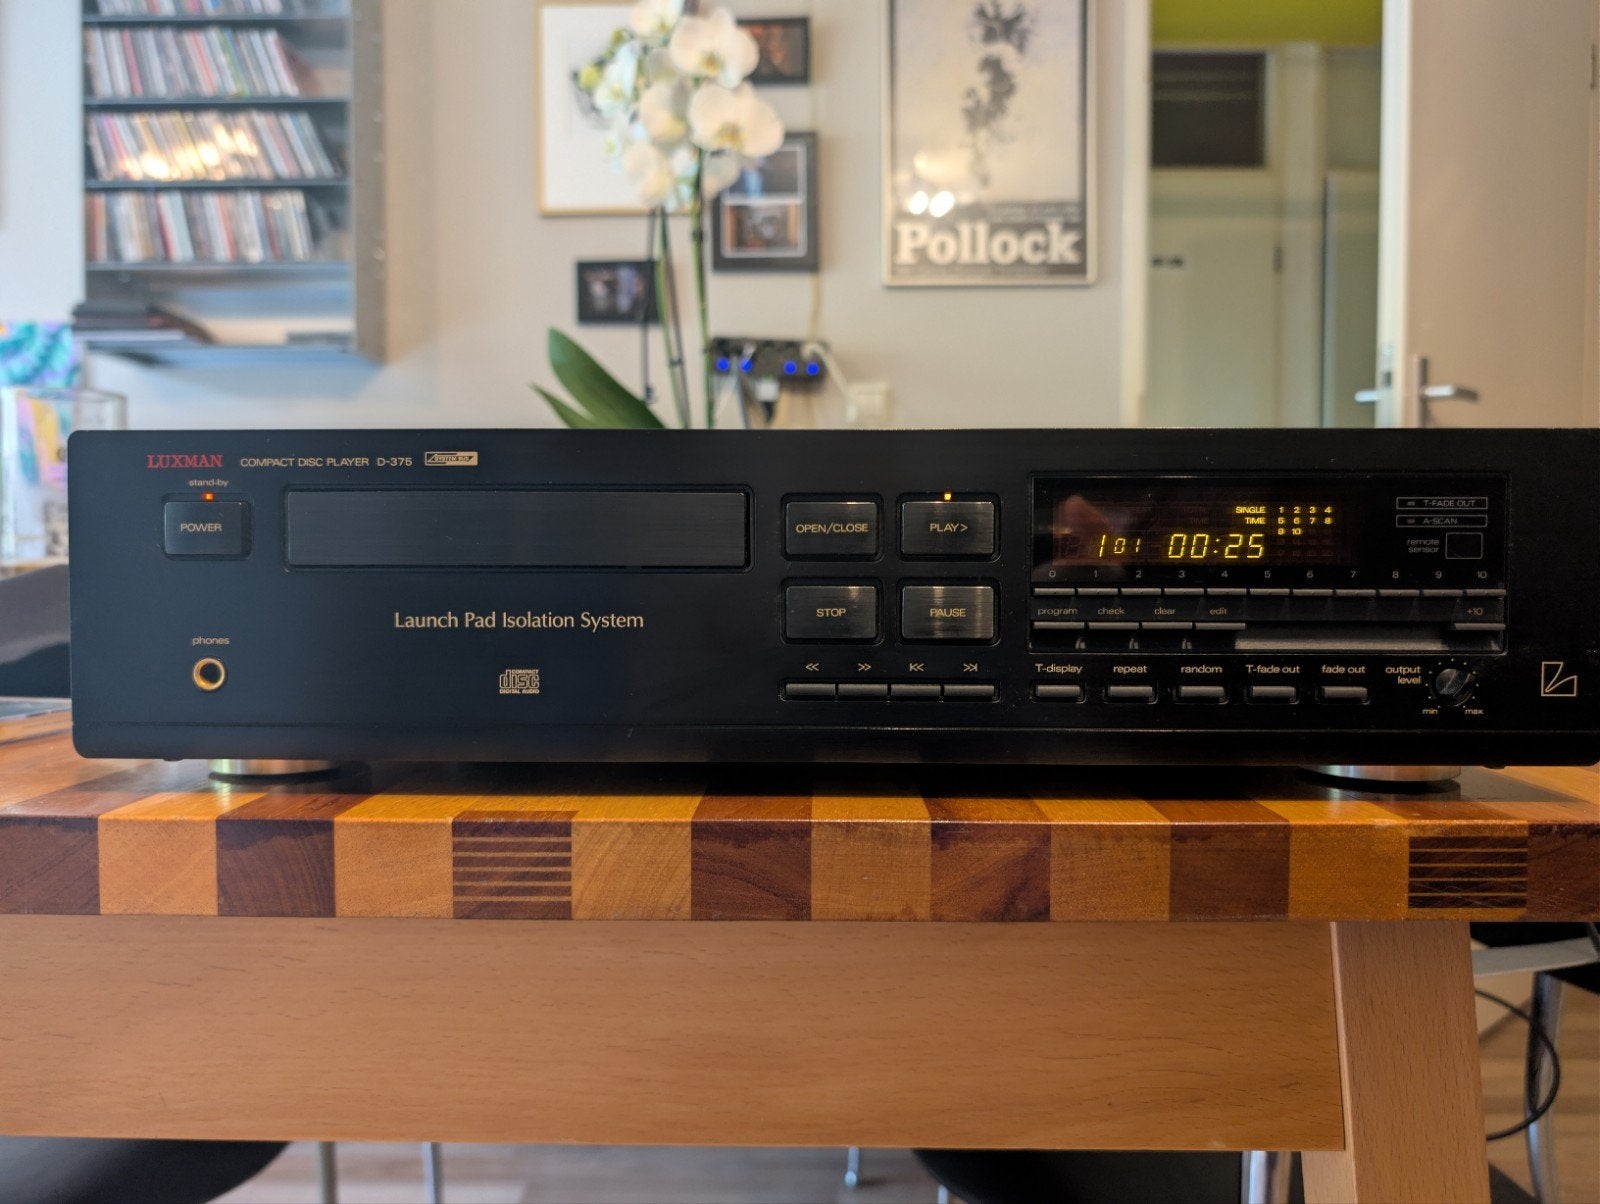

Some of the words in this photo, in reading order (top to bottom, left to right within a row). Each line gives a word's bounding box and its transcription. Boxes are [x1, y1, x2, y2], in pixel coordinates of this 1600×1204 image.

[895, 218, 1082, 266] Pollock
[146, 454, 224, 469] LUXMAN
[240, 457, 295, 467] COMPACT
[298, 457, 323, 467] DISC
[326, 457, 370, 467] PLAYER
[377, 457, 413, 467] D-375
[188, 478, 229, 488] stand-by
[1424, 499, 1455, 507] T-FADE
[1456, 499, 1476, 507] OUT
[1235, 506, 1267, 515] SINGLE
[1278, 506, 1285, 514] 1
[1293, 506, 1301, 514] 2
[1309, 506, 1317, 514] 3
[1324, 506, 1333, 514] 4
[1244, 517, 1267, 525] TIME
[1277, 517, 1285, 525] 5
[1293, 517, 1301, 525] 6
[1309, 517, 1317, 525] 7
[1422, 517, 1458, 525] A-SCAN
[180, 523, 223, 532] POWER
[795, 522, 869, 534] OPEN/CLOSE
[1277, 527, 1285, 536] 9
[1291, 527, 1302, 536] 10
[1168, 533, 1265, 559] 00:25
[1406, 538, 1440, 546] remote
[1093, 569, 1099, 579] 1
[1135, 570, 1143, 579] 2
[1178, 570, 1187, 579] 3
[1221, 570, 1229, 579] 4
[1264, 570, 1272, 579] 5
[1306, 570, 1315, 579] 6
[1350, 570, 1357, 579] 7
[1391, 570, 1400, 579] 8
[1435, 570, 1443, 579] 9
[1476, 570, 1488, 579] 10
[815, 608, 847, 618] STOP
[929, 608, 967, 618] PAUSE
[1037, 607, 1079, 616] program
[1097, 605, 1126, 616] check
[1154, 605, 1176, 616] clear
[1209, 606, 1228, 616] edit
[394, 611, 459, 629] Launch
[464, 611, 497, 629] Pad
[502, 611, 575, 629] Isolation
[580, 611, 645, 634] System
[191, 636, 230, 646] phones
[1034, 663, 1083, 675] T-display
[1113, 665, 1148, 674] repeat
[1180, 665, 1223, 674] random
[1246, 664, 1280, 674] T-fade
[1281, 665, 1300, 674] out
[1321, 664, 1346, 674] fade
[1348, 665, 1366, 674] out
[1385, 665, 1421, 675] output
[1397, 675, 1421, 685] level
[1422, 707, 1438, 715] min
